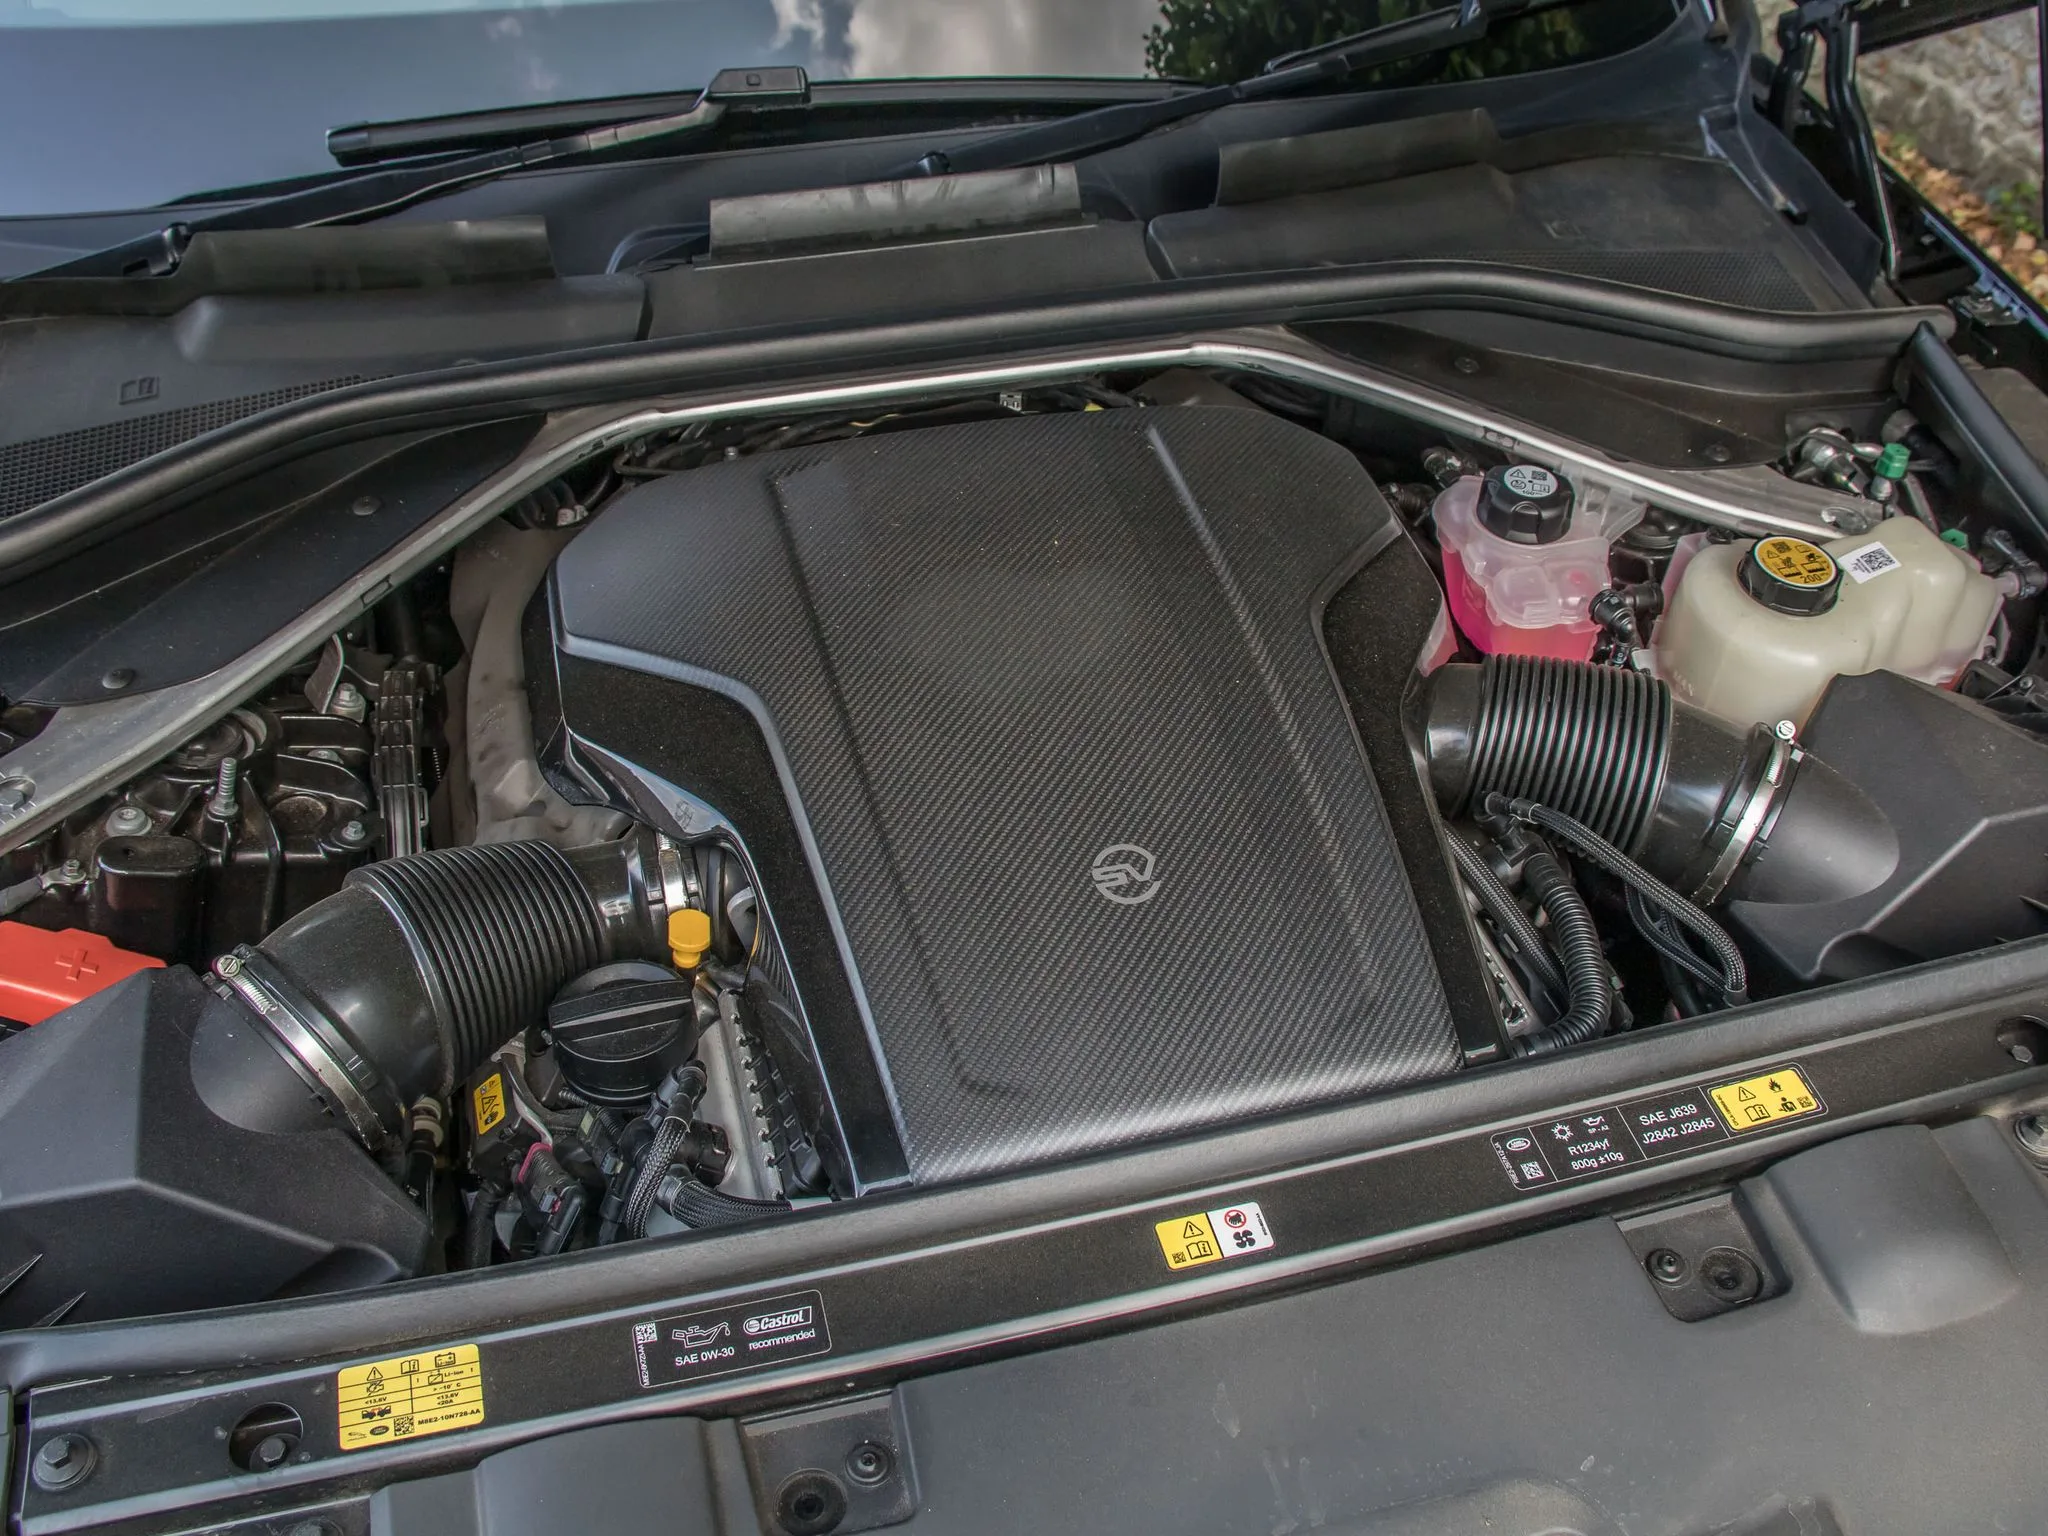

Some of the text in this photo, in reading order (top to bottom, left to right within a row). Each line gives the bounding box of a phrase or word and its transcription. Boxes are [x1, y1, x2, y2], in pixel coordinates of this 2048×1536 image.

[1640, 1103, 1697, 1125] SAE J639
[1643, 1117, 1715, 1144] J2842 J2845
[1568, 1138, 1610, 1156] R1234yf
[1571, 1151, 1624, 1171] 800g ±10g
[760, 1309, 805, 1330] Castrol
[748, 1328, 816, 1351] recommended
[675, 1346, 735, 1367] SAE 0W-30
